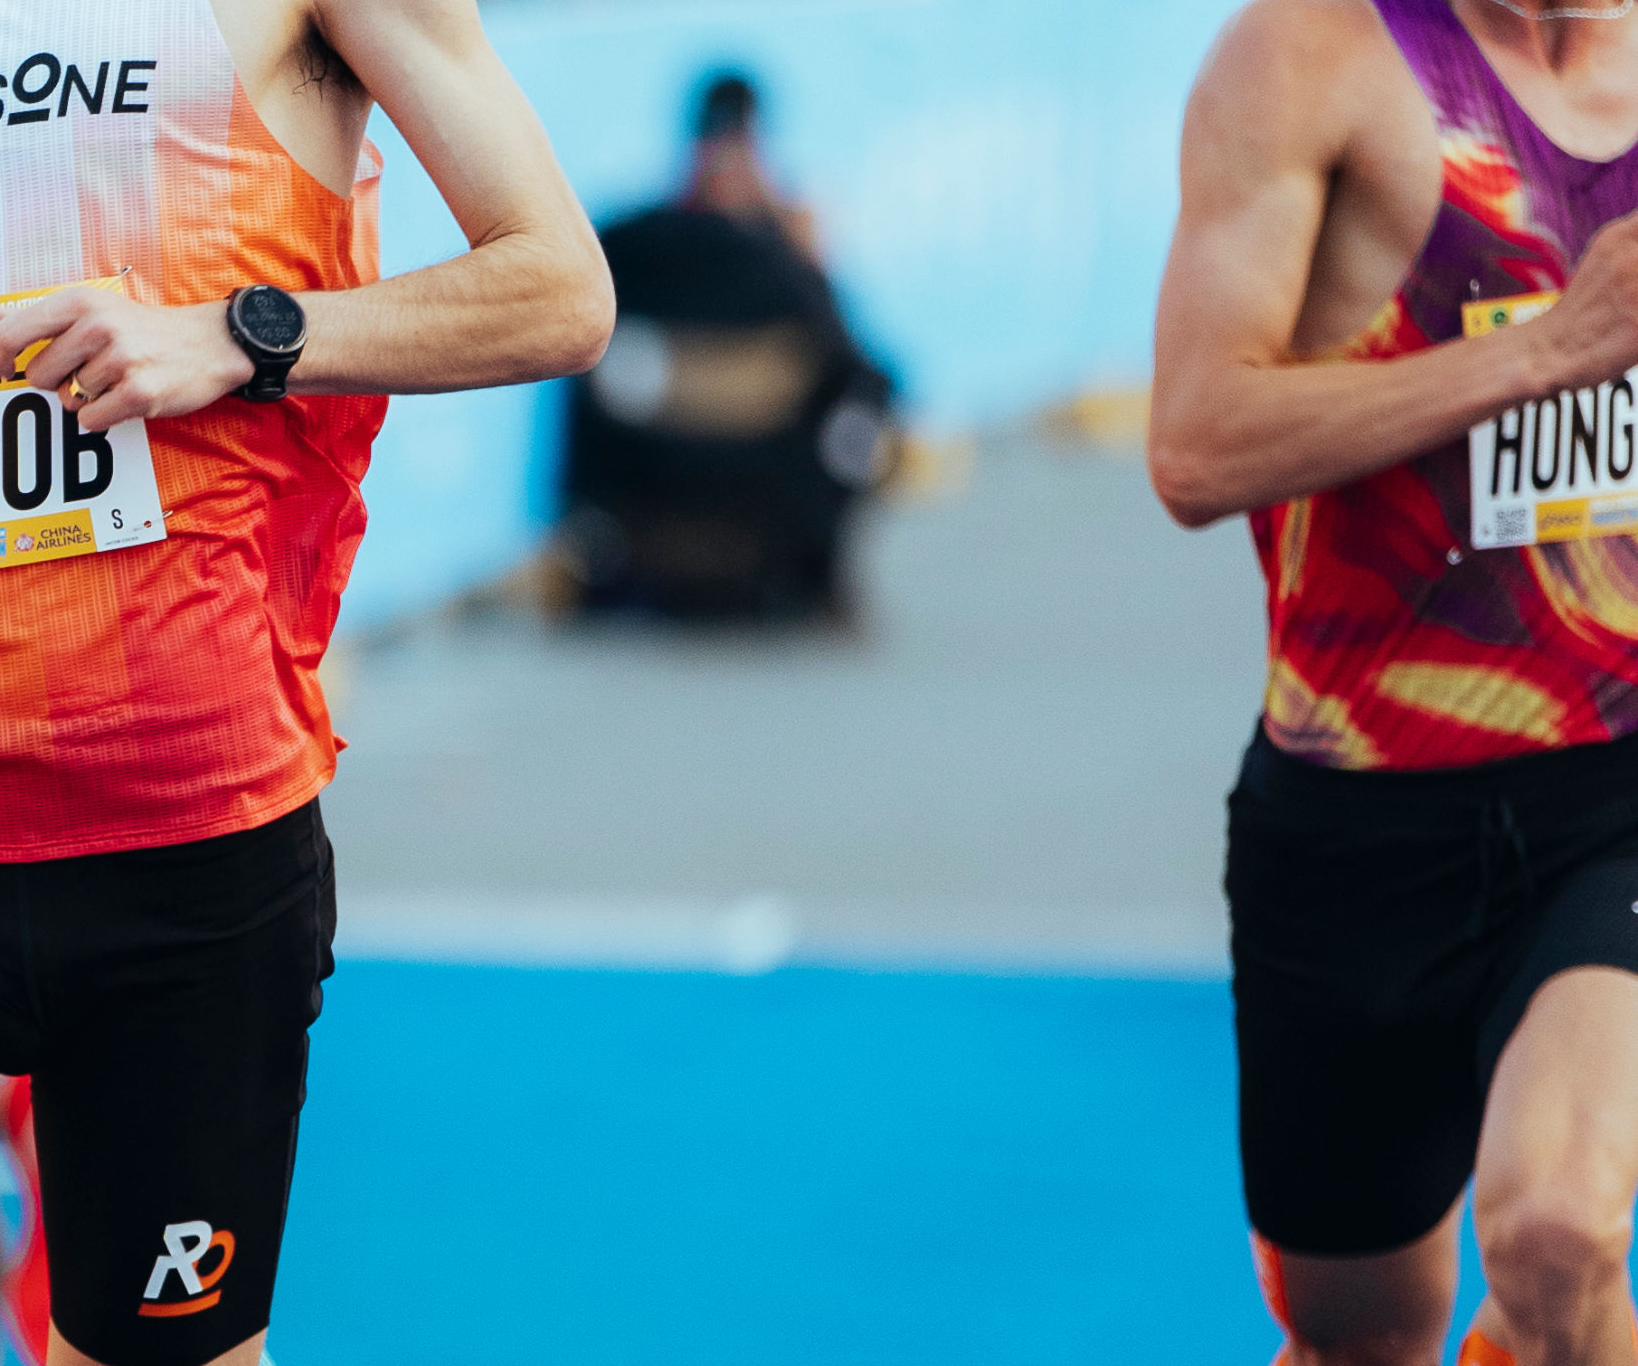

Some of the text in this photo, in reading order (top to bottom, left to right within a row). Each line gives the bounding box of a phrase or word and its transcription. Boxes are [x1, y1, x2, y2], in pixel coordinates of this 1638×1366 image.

[1490, 379, 1634, 497] HONG
[111, 508, 124, 530] S
[35, 532, 92, 551] AIRLINES
[40, 524, 82, 540] CHINA
